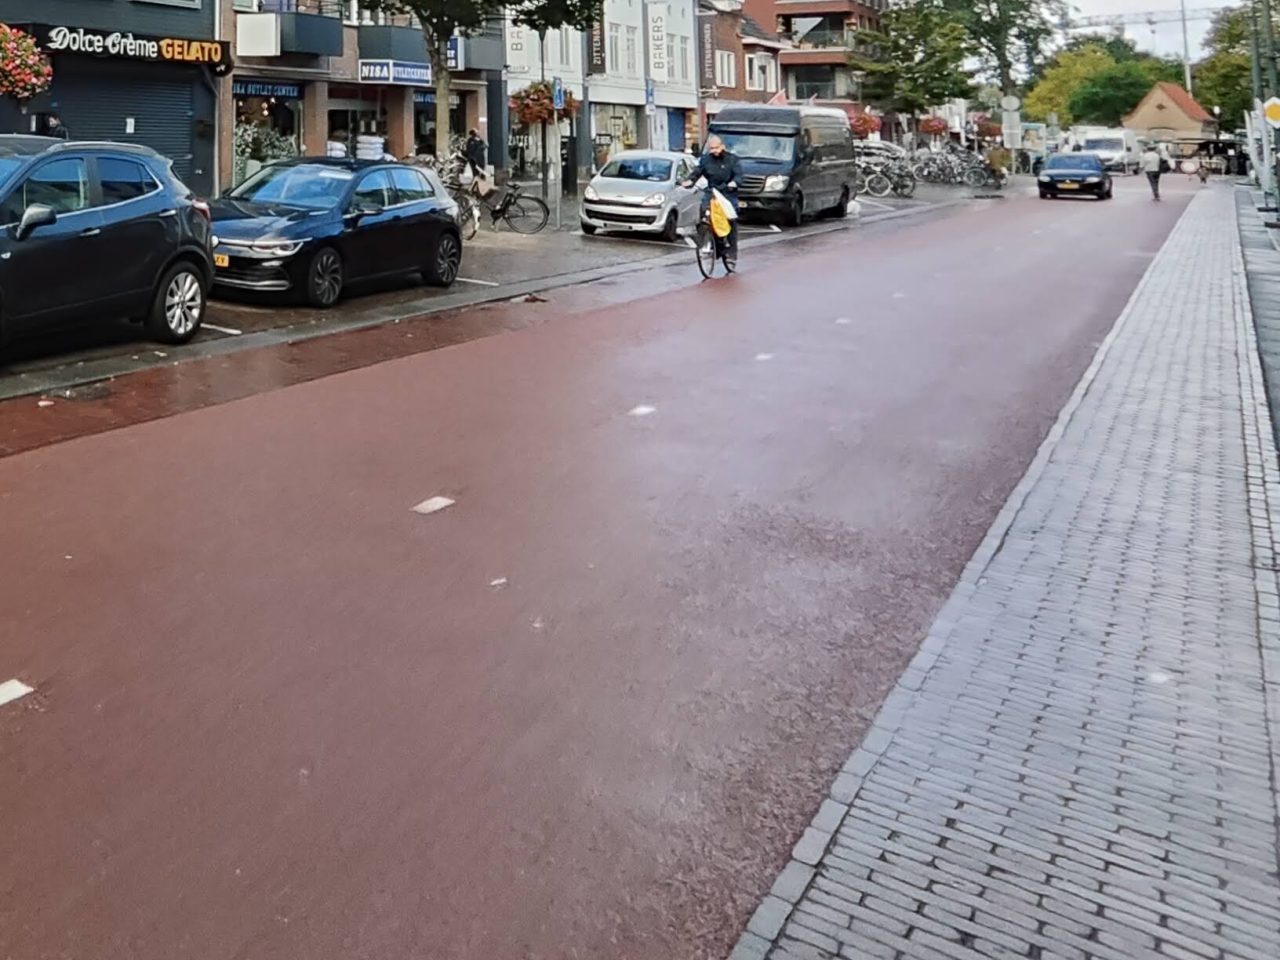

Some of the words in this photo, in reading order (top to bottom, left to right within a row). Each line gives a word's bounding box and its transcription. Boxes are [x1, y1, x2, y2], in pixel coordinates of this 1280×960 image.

[48, 26, 103, 53] Dolce
[104, 32, 158, 58] Crème
[158, 38, 222, 62] GELATO
[361, 65, 389, 78] NISA
